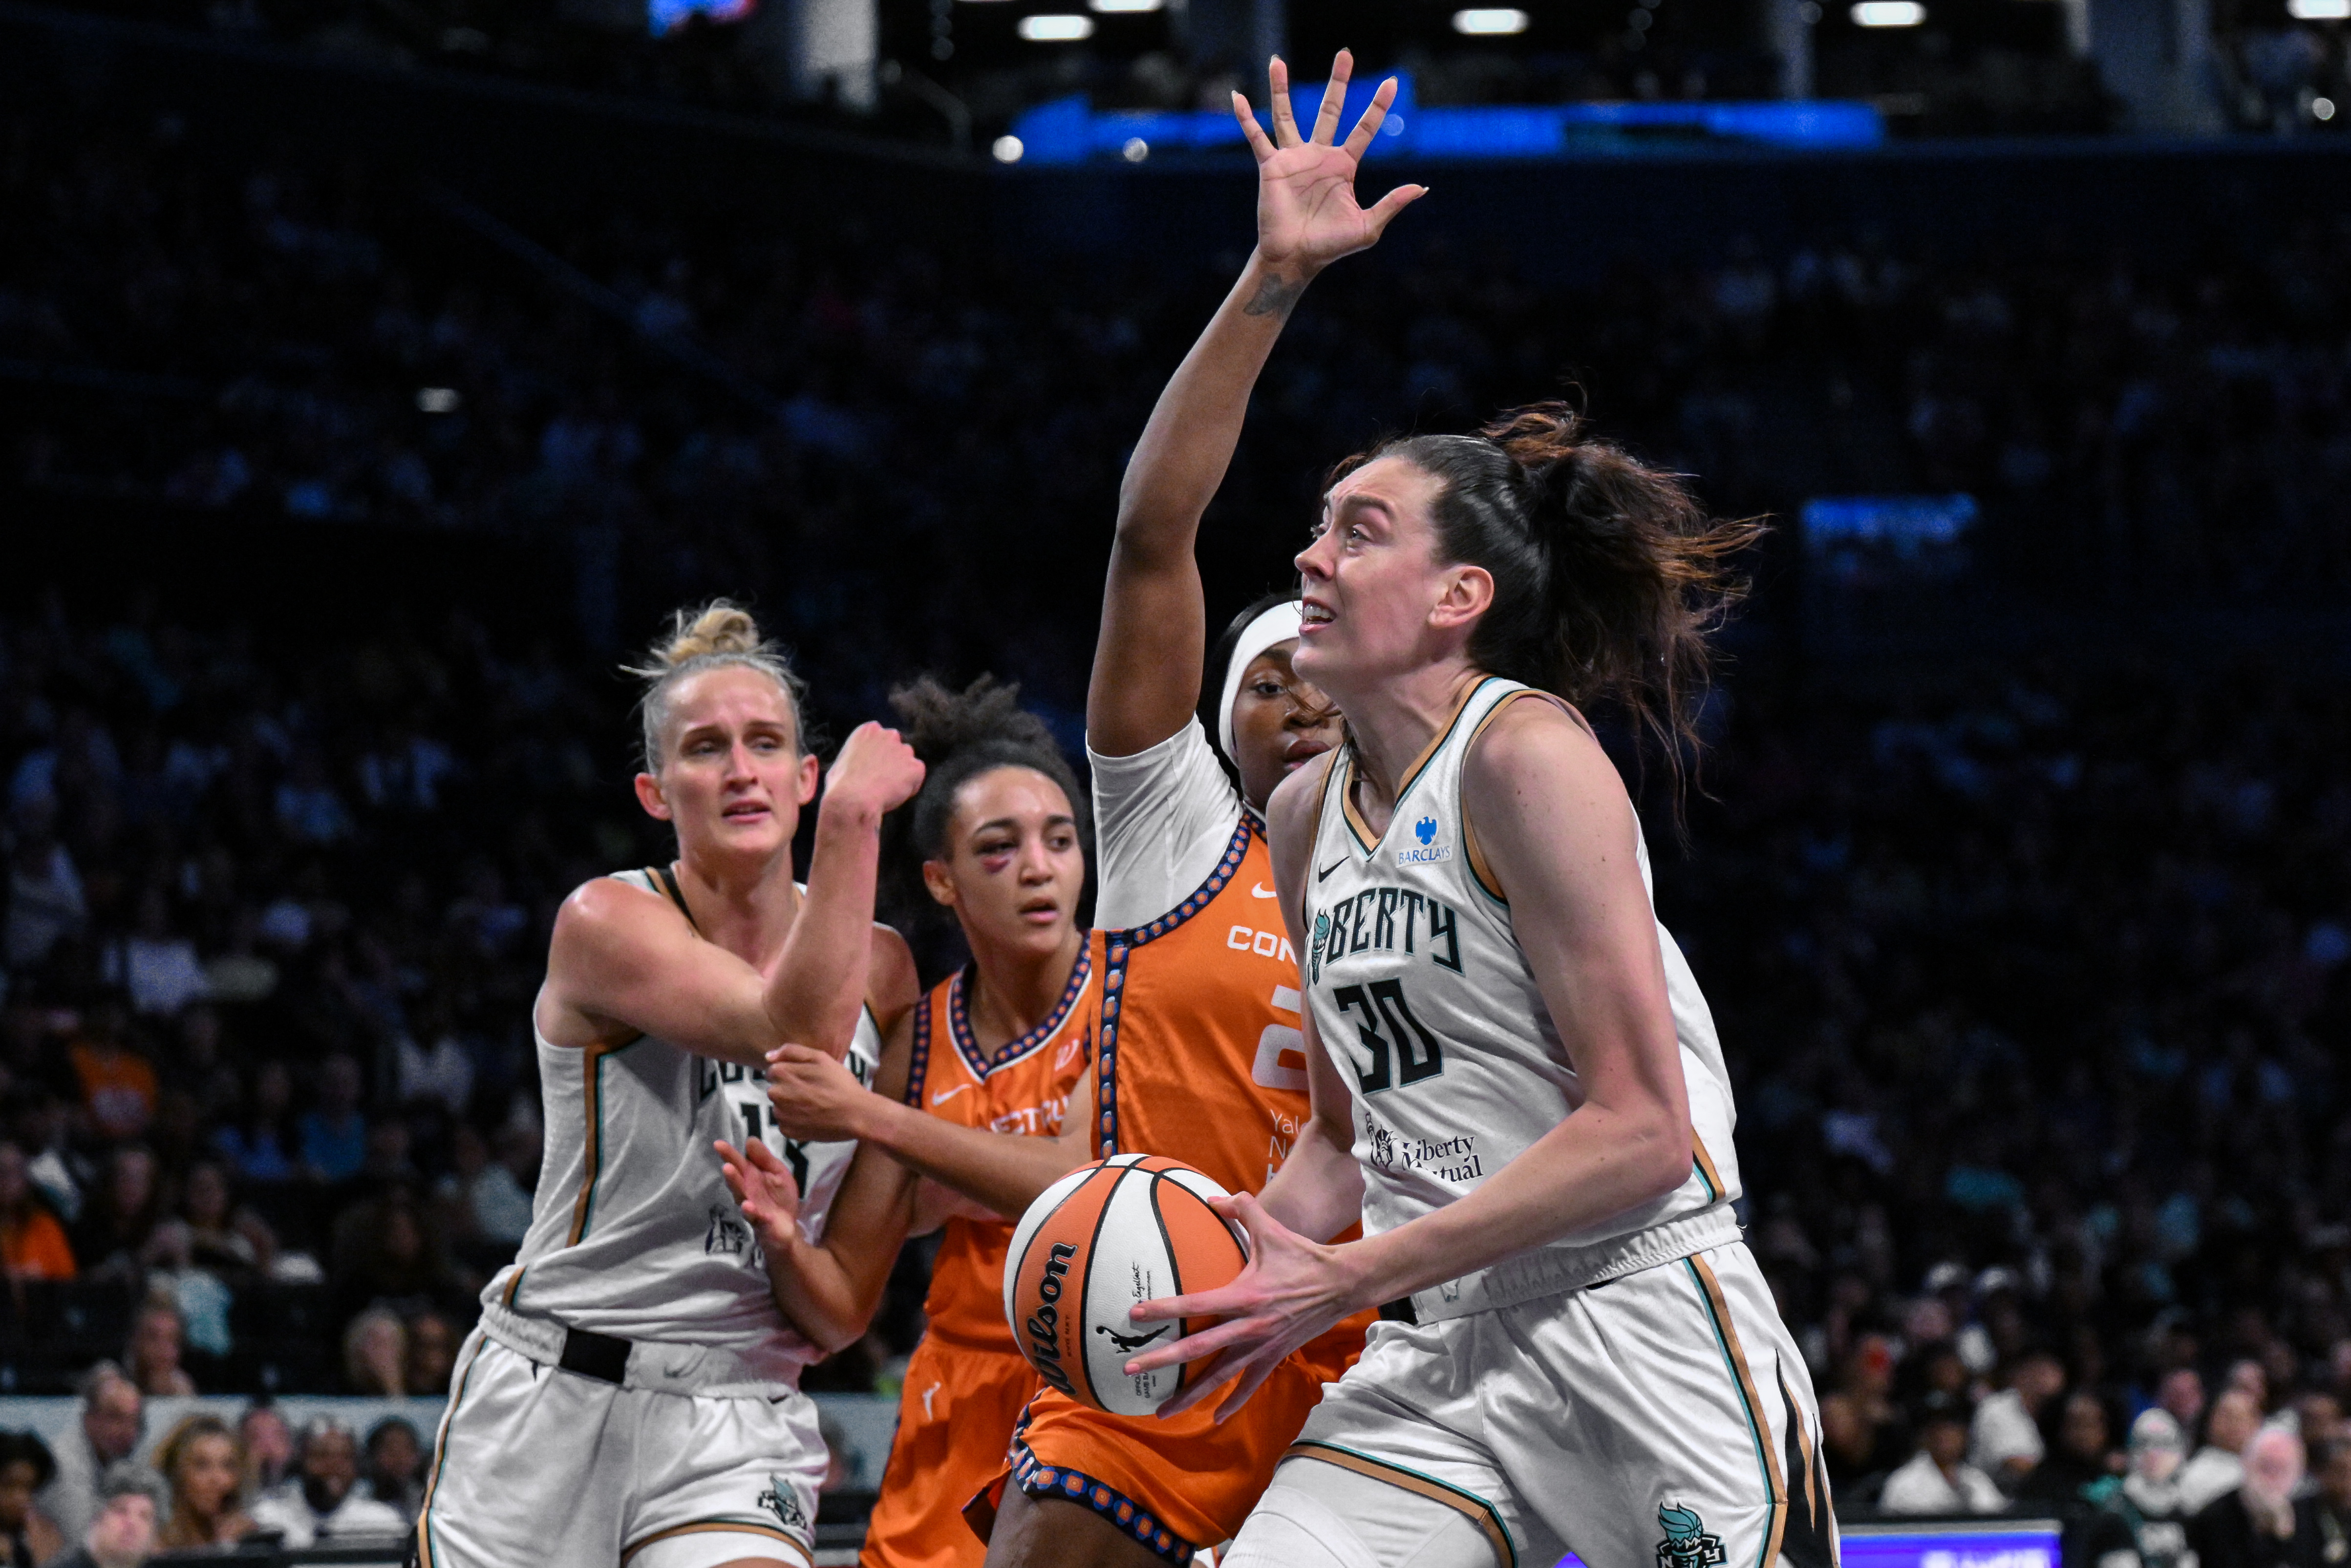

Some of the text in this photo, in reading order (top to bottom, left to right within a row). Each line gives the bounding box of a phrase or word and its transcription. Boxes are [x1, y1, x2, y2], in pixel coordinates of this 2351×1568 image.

[1399, 845, 1450, 865] BARCLAYS
[1332, 977, 1445, 1096] 30
[1270, 1109, 1304, 1135] Yal
[1402, 1152, 1484, 1182] Mtual
[1027, 1242, 1078, 1395] Wilson
